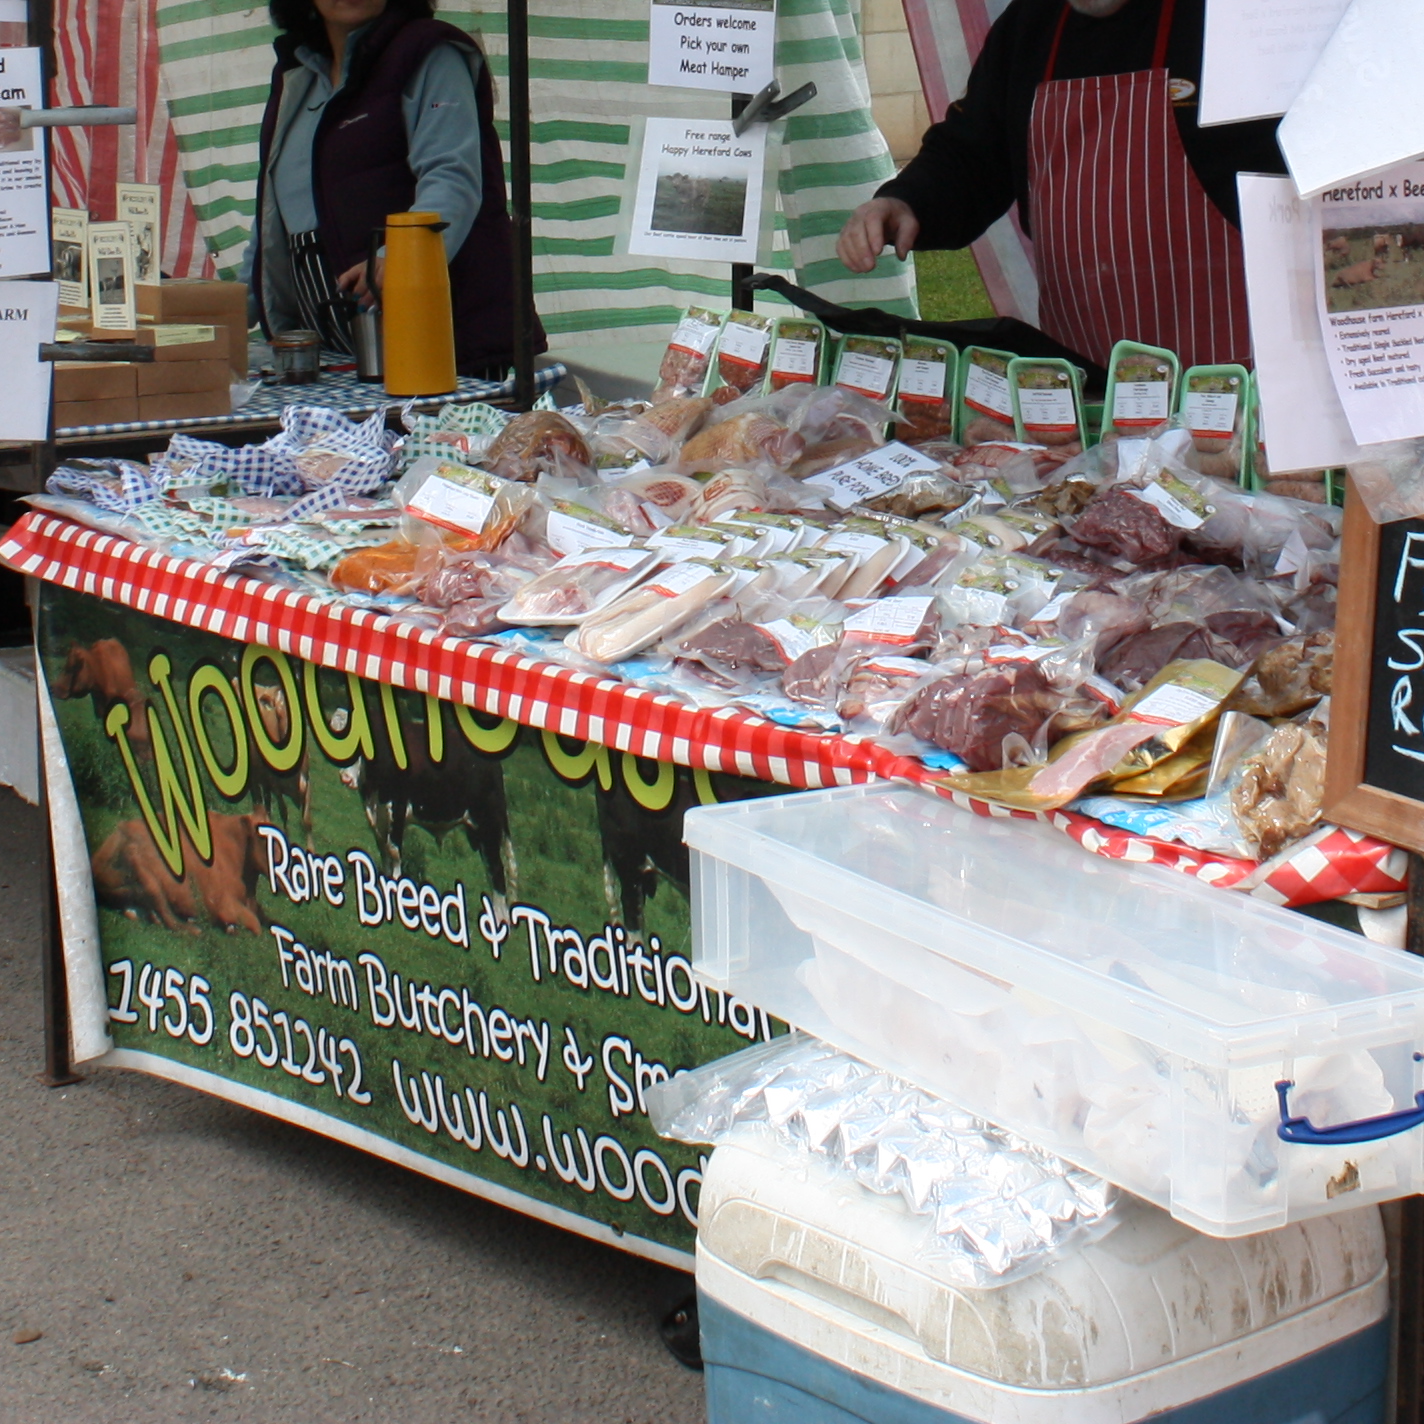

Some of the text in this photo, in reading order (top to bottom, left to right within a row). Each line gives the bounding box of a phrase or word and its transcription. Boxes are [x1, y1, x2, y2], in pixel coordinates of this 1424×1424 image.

[674, 12, 757, 31] Orders welcome
[680, 35, 750, 55] Pick your own
[680, 60, 749, 80] Meat Hamper
[685, 129, 731, 143] Free range
[661, 144, 753, 158] Happy Hereford Cows
[1322, 181, 1383, 202] Hereford
[1389, 185, 1398, 198] x
[1329, 315, 1366, 326] Woodhouse
[1368, 313, 1384, 323] farm
[1386, 309, 1416, 322] Hereford
[258, 825, 344, 907] Rare
[348, 850, 467, 948] Breed
[480, 895, 509, 958] &
[271, 925, 359, 1011] Farm
[359, 954, 550, 1082] Butchery
[564, 1025, 594, 1090] &
[108, 960, 215, 1046] 1455
[230, 992, 372, 1105] 851242
